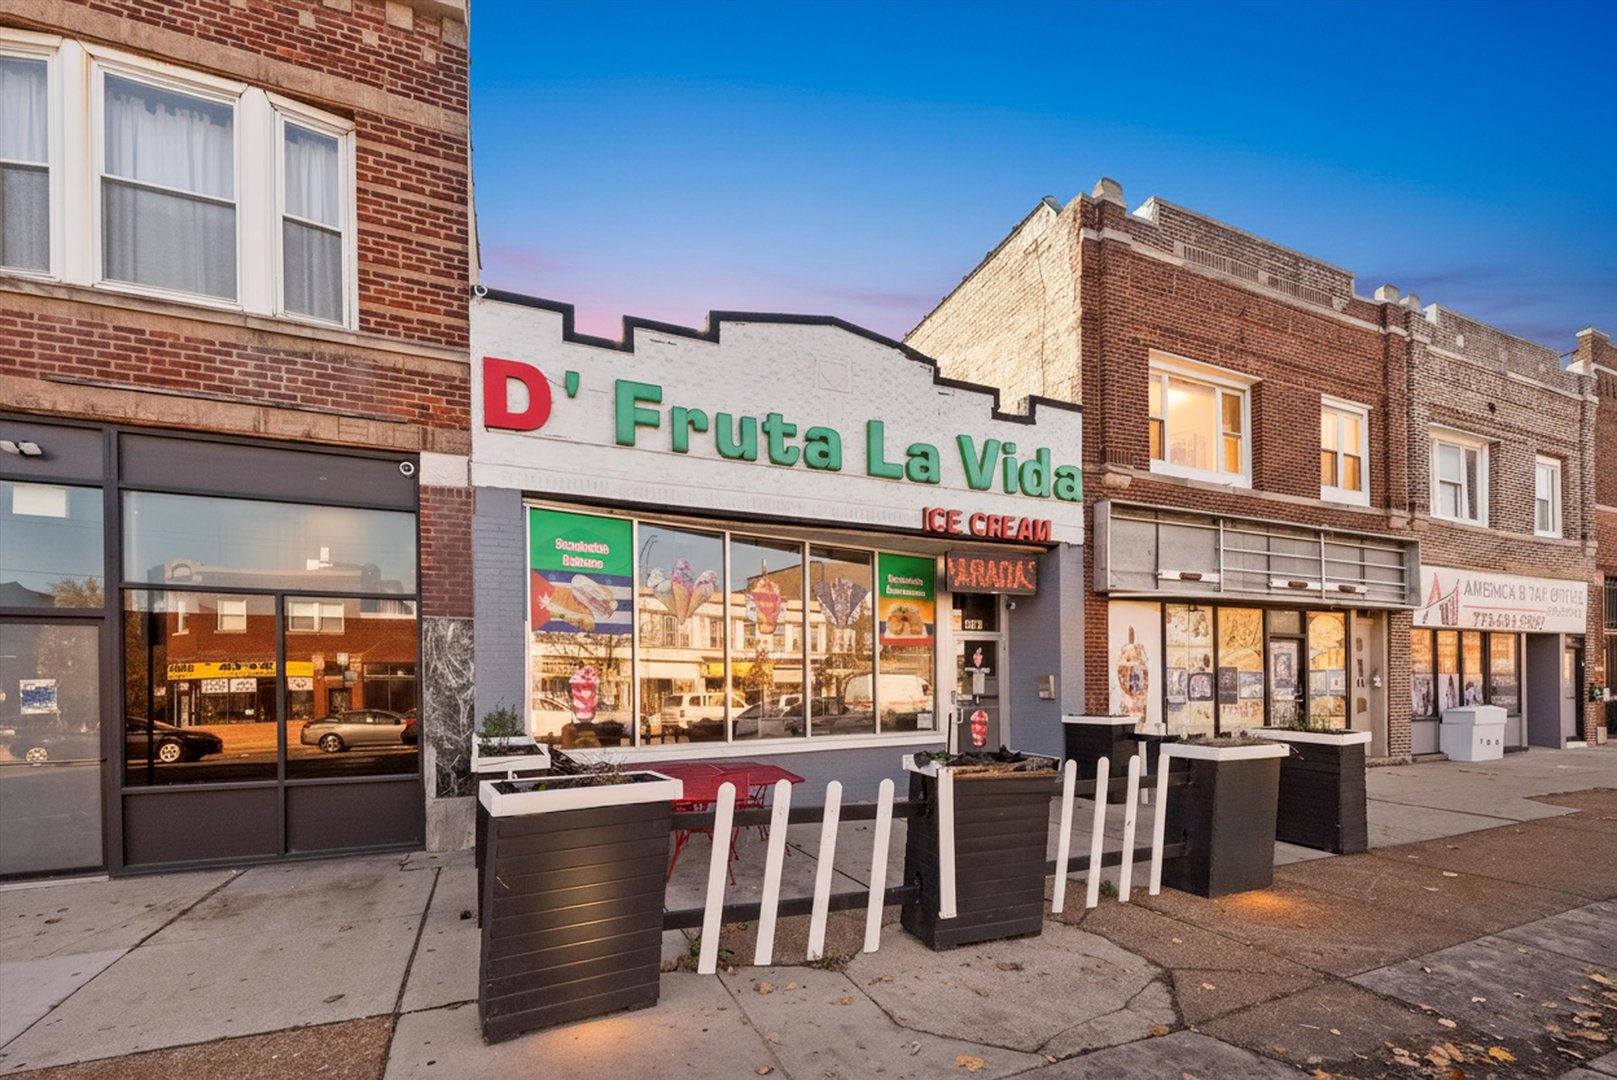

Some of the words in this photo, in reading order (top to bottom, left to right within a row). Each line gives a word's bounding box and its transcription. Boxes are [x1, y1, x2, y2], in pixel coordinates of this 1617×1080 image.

[615, 379, 843, 472] Fruta
[867, 420, 941, 484] La
[956, 434, 1083, 502] Vida
[922, 506, 963, 534] ICE
